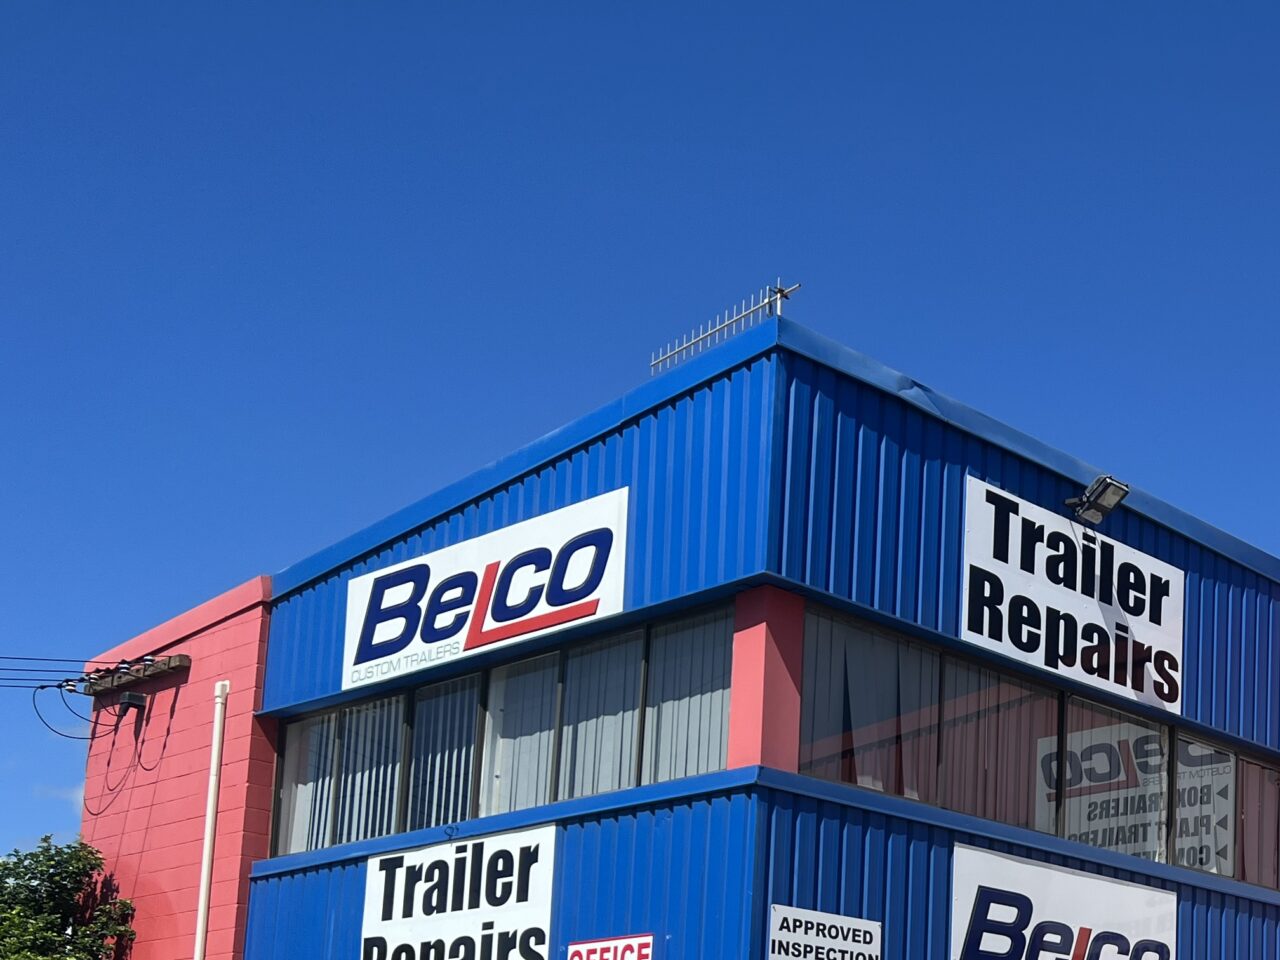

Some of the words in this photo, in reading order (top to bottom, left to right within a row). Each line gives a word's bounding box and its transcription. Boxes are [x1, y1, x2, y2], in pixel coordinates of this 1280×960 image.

[986, 488, 1170, 626] Trailer
[350, 658, 400, 684] CUSTOM
[404, 641, 460, 668] TRAILERS
[967, 563, 1180, 704] Repairs
[378, 841, 540, 922] Trailer
[778, 916, 874, 945] APPROVED
